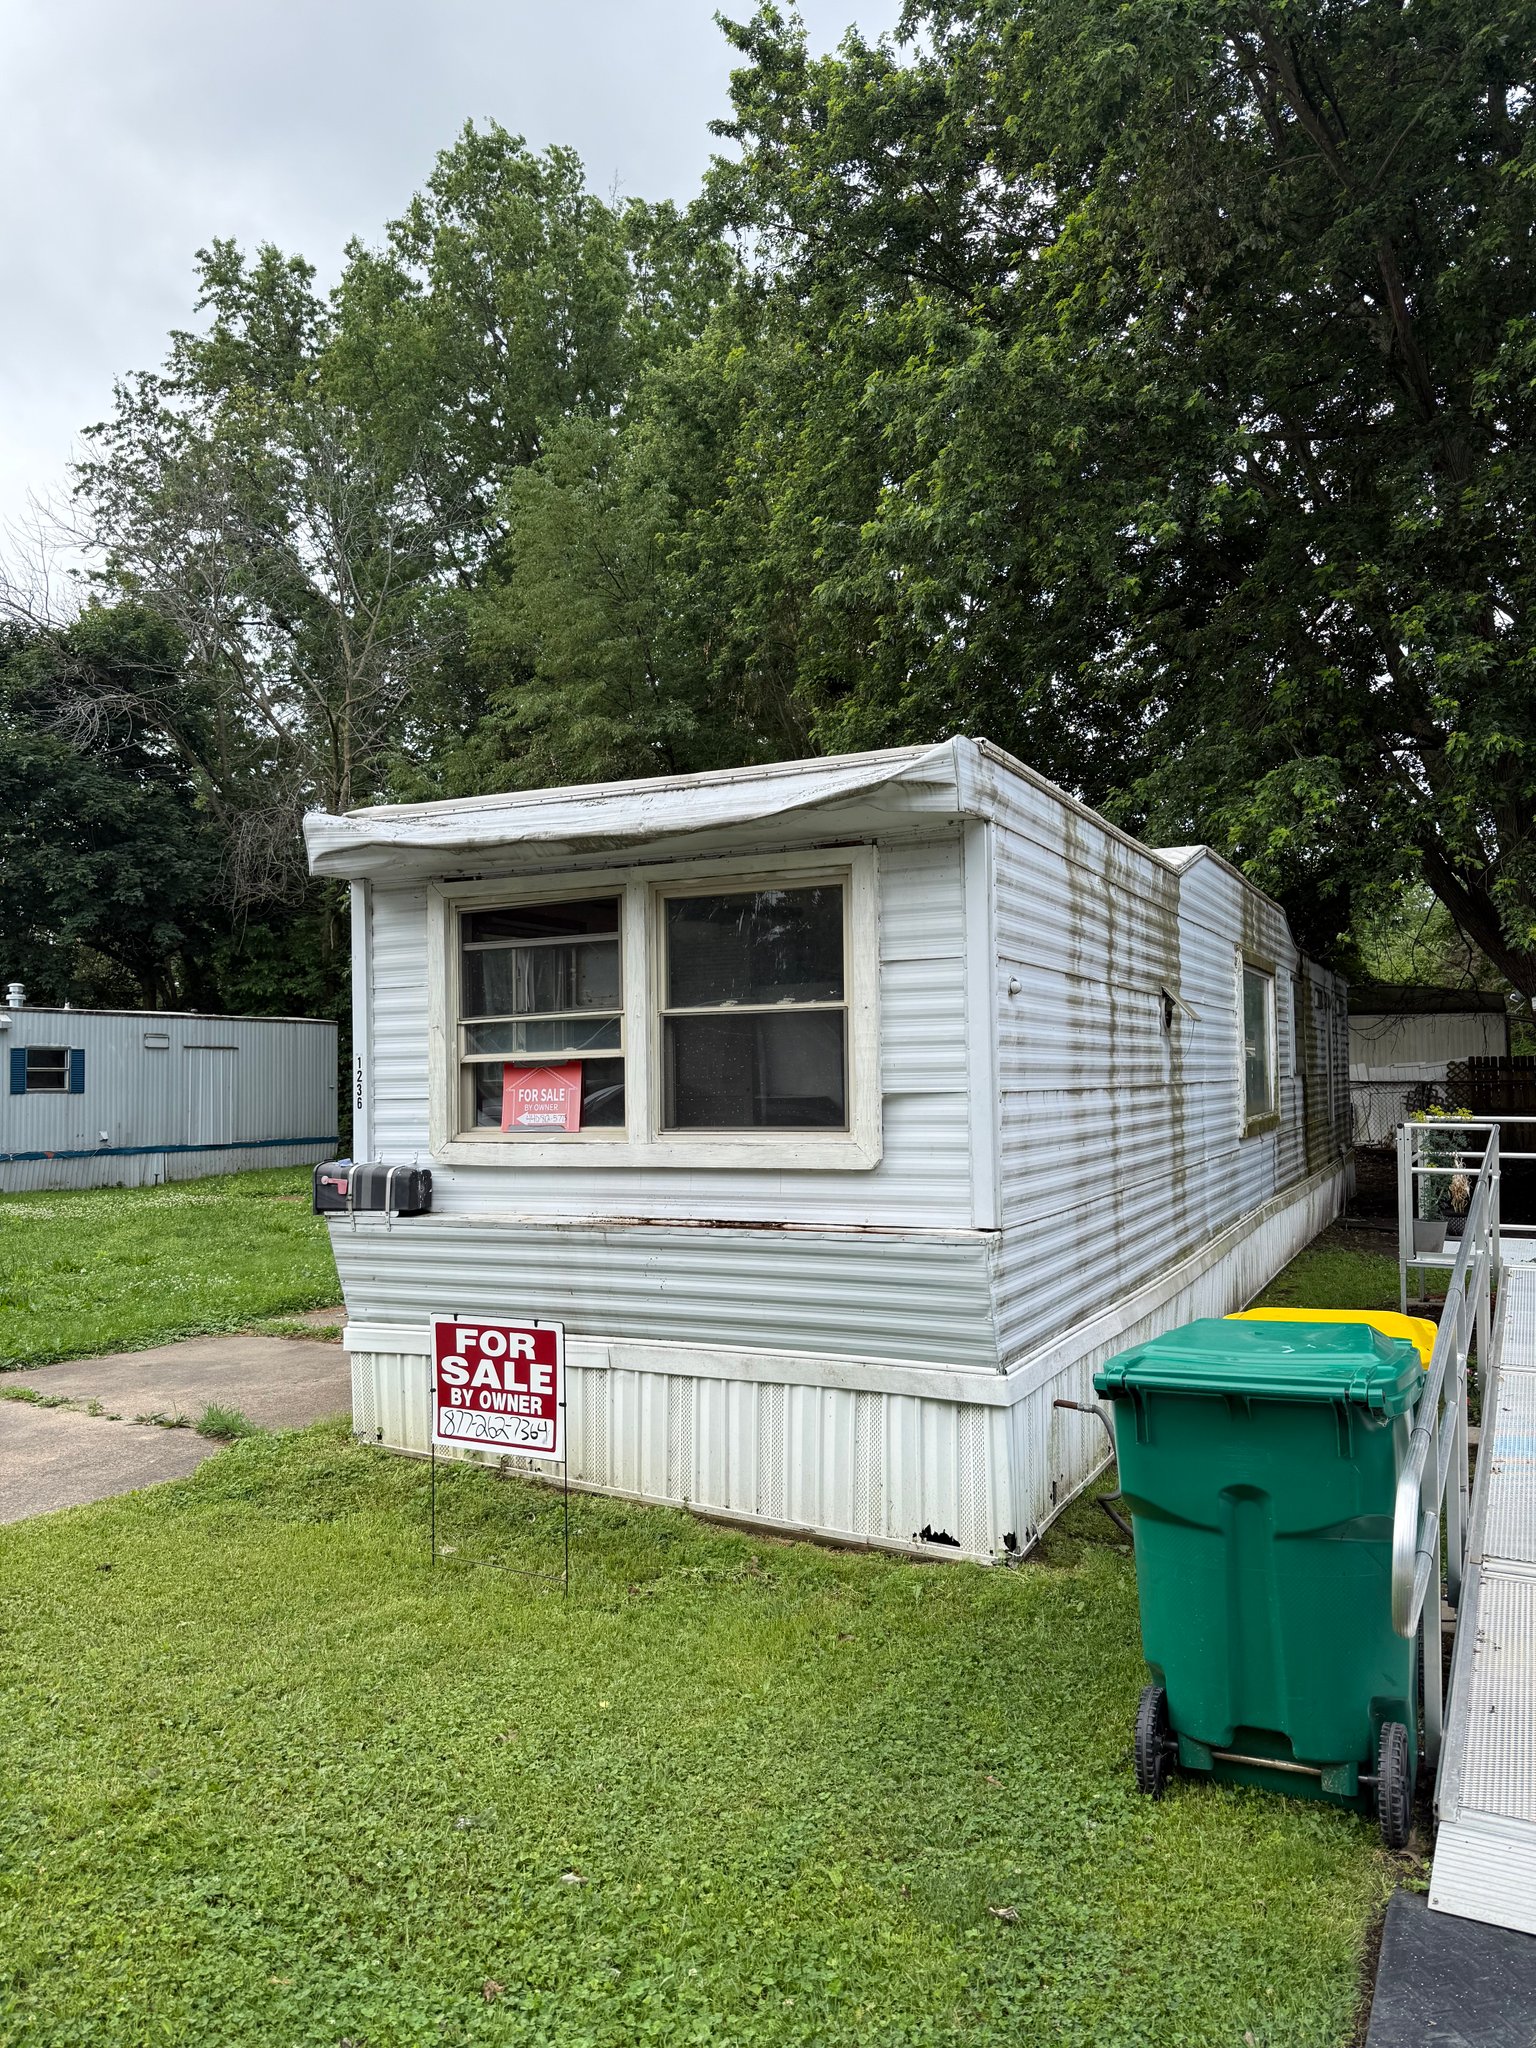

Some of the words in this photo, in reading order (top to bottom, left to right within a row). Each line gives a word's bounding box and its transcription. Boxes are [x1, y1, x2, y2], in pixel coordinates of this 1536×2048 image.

[518, 1088, 539, 1102] FOR
[541, 1088, 565, 1102] SALE
[524, 1103, 533, 1112] BY
[533, 1103, 559, 1111] OWNER
[455, 1328, 536, 1360] FOR
[441, 1355, 553, 1395] SALE
[450, 1387, 474, 1407] BY
[479, 1390, 543, 1415] OWNER
[444, 1410, 549, 1443] 877-262-7364
